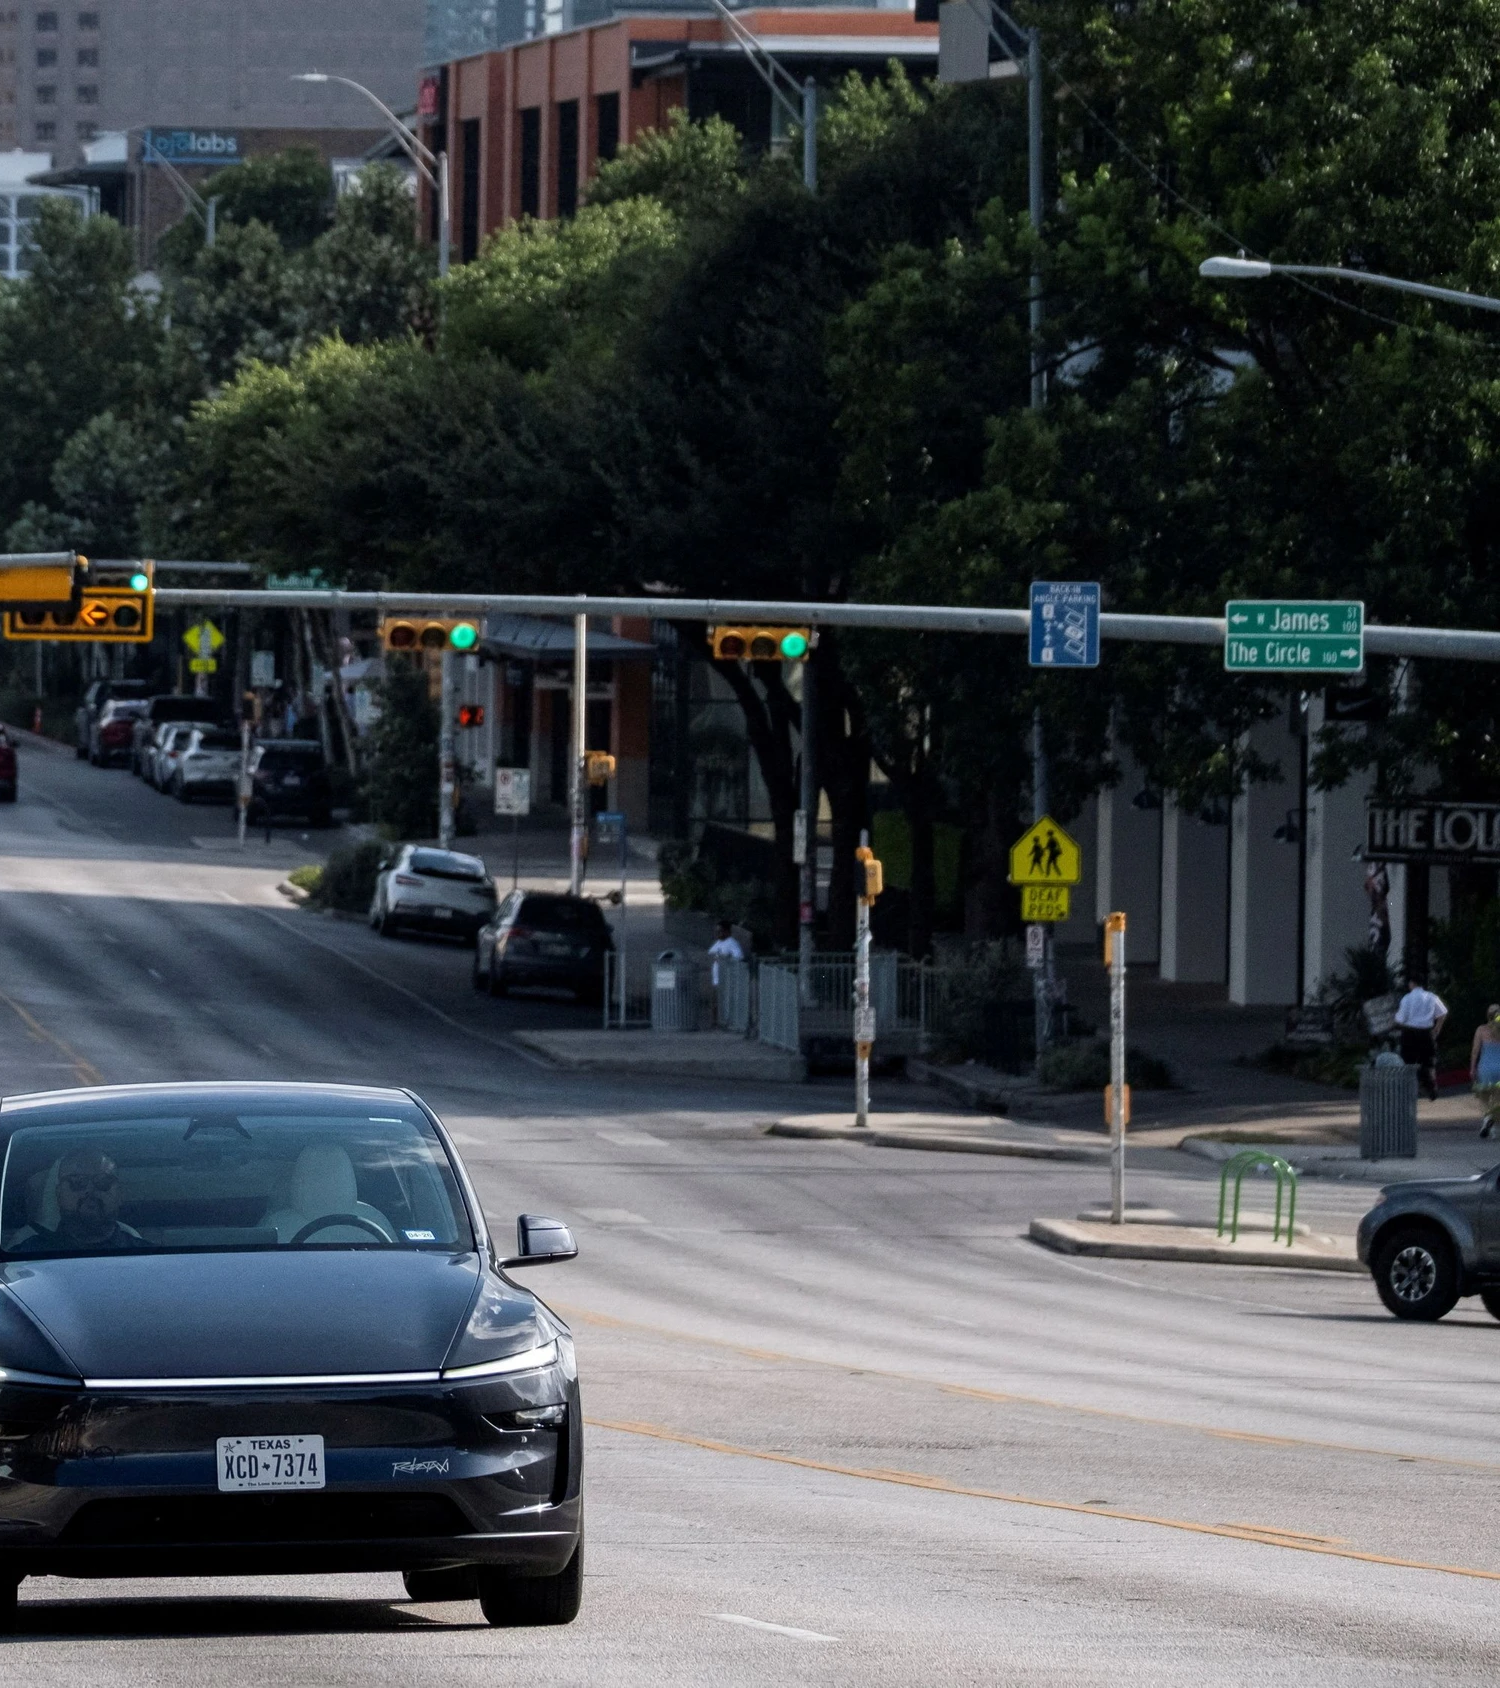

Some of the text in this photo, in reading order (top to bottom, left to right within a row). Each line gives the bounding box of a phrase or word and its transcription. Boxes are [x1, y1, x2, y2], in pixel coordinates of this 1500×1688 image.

[1062, 594, 1097, 604] PARKING
[1269, 607, 1330, 632] James
[1347, 607, 1357, 619] ST
[1342, 621, 1358, 632] 100
[1230, 642, 1337, 664] The Circle 100
[1369, 807, 1428, 849] THE
[1029, 887, 1063, 901] DEAF
[250, 1439, 291, 1450] TEXAS
